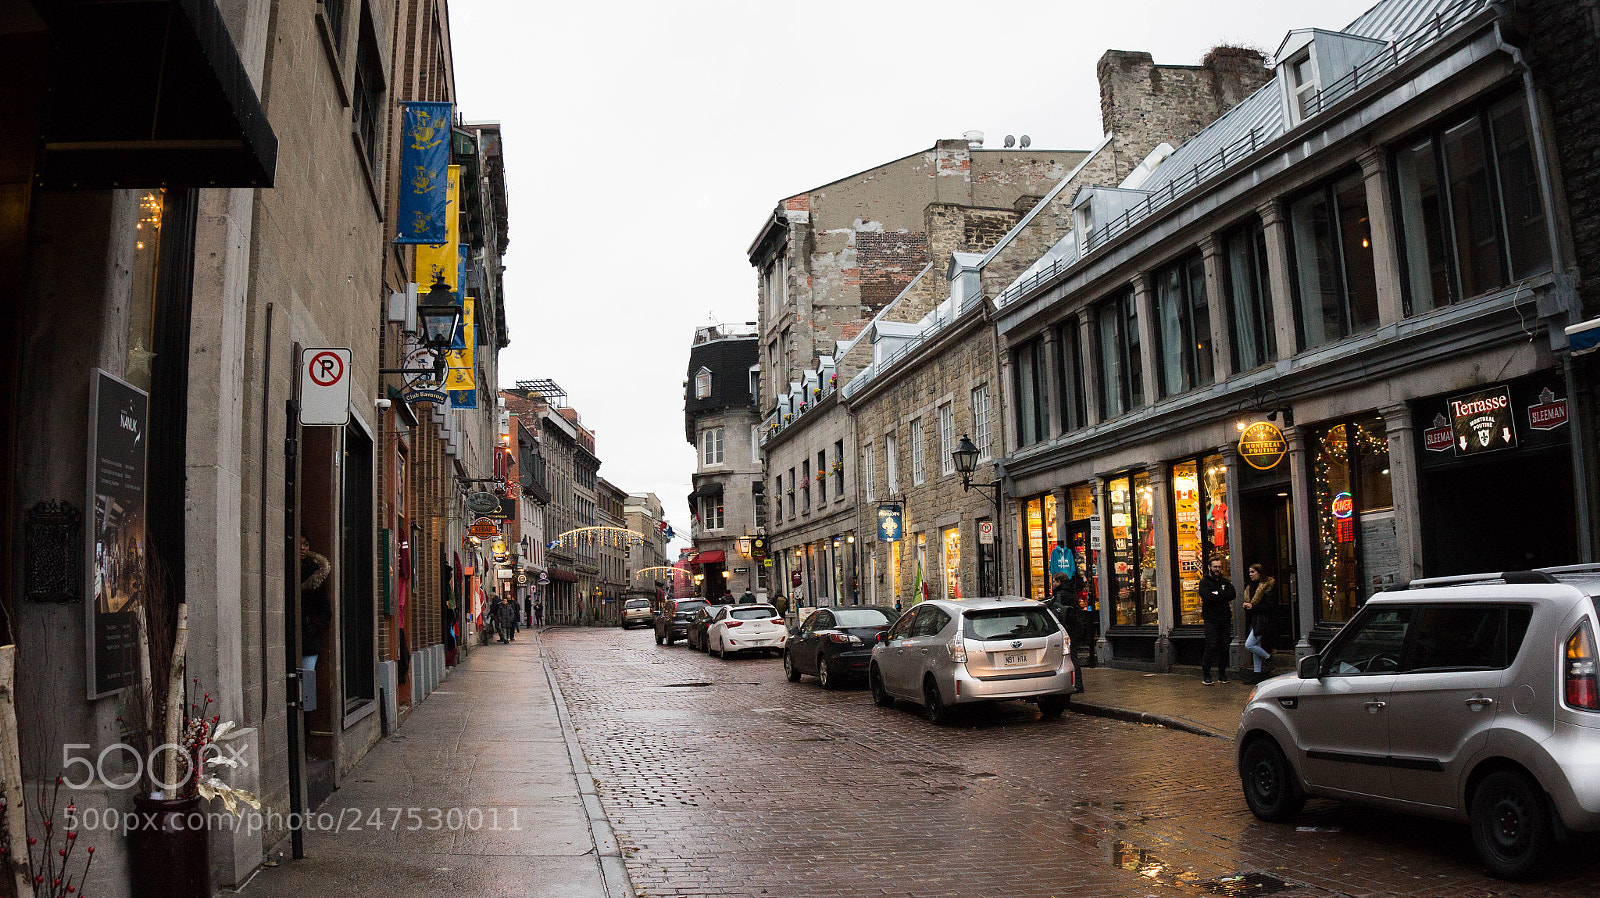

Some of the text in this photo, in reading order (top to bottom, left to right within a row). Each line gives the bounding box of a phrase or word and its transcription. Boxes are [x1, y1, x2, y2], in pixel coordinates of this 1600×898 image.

[1451, 394, 1508, 419] Terrasse
[1469, 415, 1496, 428] MONTREAL
[1531, 405, 1565, 424] SLEEMAN
[1245, 424, 1278, 438] RESTO BAR
[1472, 421, 1494, 431] POUTINE
